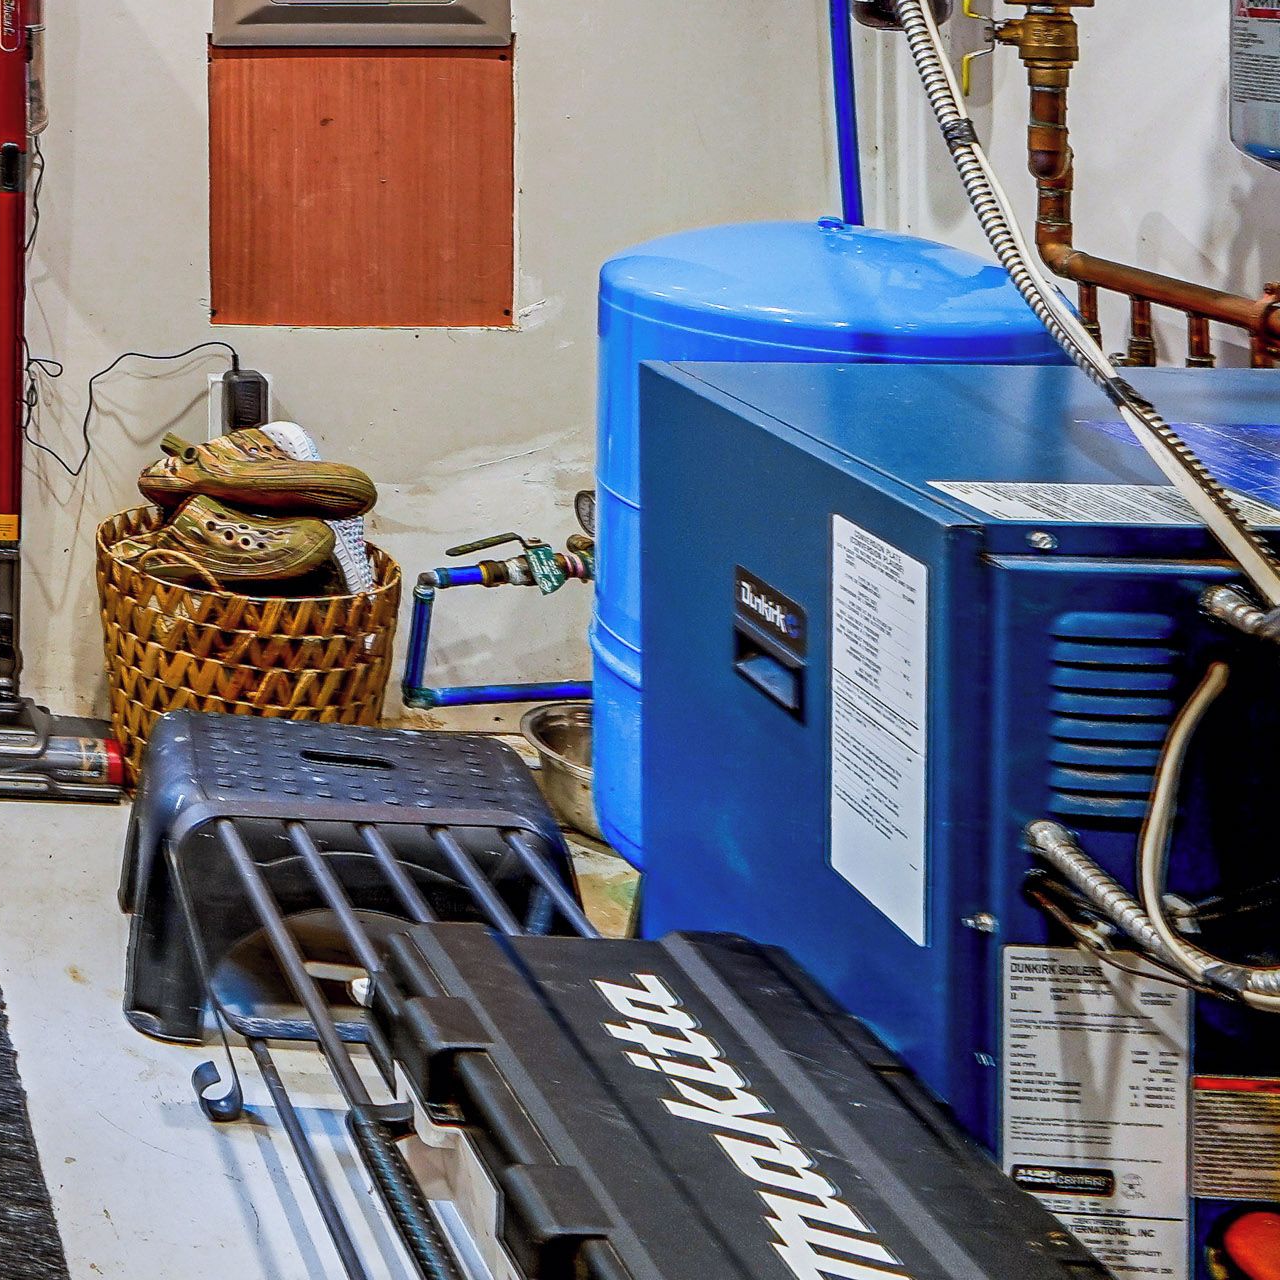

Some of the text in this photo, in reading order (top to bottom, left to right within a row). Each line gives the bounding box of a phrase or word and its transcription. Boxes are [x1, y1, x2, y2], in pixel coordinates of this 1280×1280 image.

[741, 580, 788, 634] Dunkirk
[1010, 963, 1104, 977] DUNKIRK BOILERS
